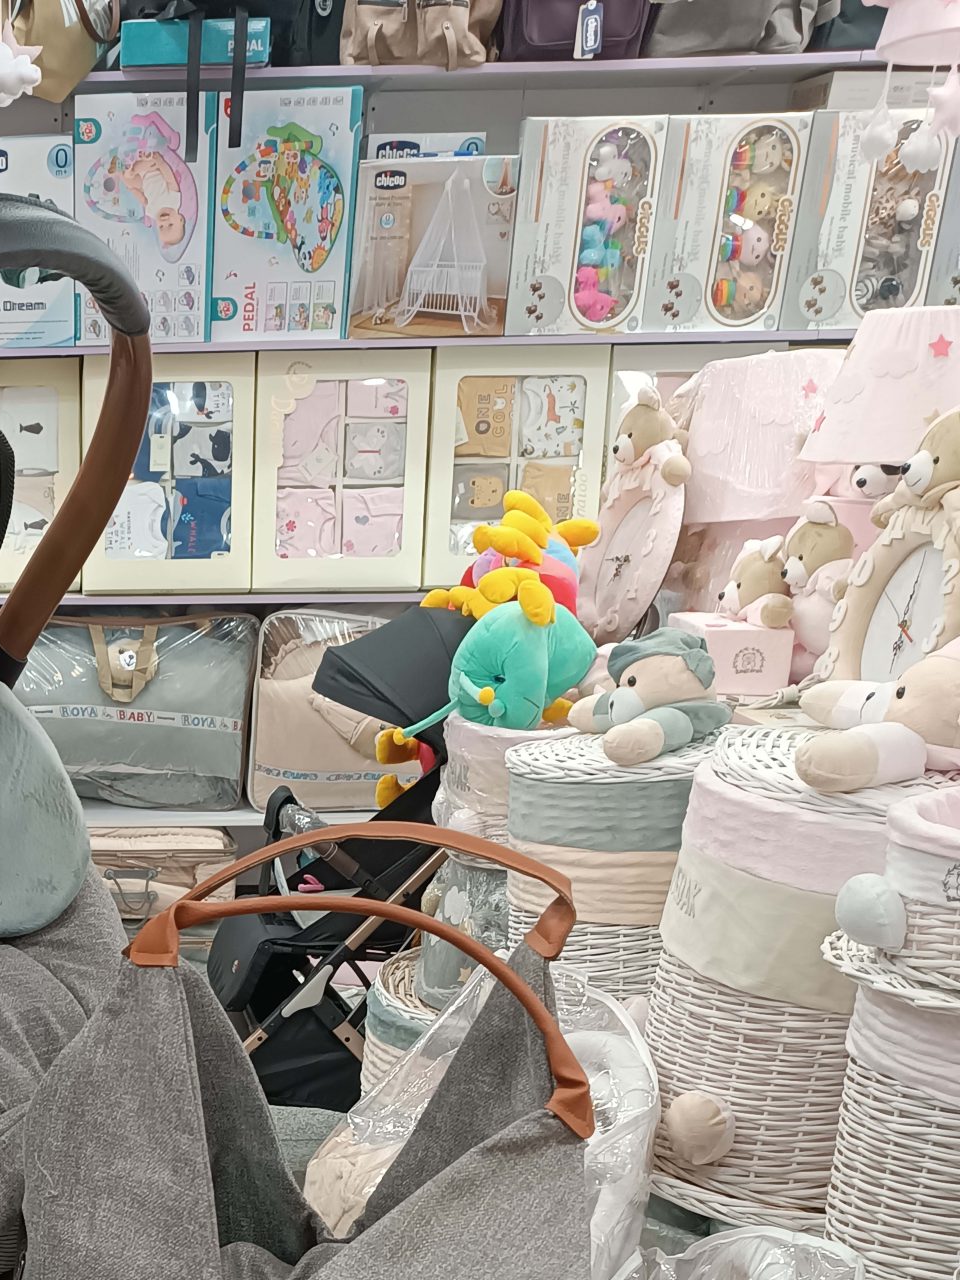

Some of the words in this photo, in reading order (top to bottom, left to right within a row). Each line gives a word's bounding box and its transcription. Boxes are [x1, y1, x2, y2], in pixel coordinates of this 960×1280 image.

[228, 39, 264, 52] PAL
[846, 134, 860, 180] musical
[839, 183, 853, 222] mobile
[832, 225, 848, 252] baby
[242, 281, 256, 332] PEDAL
[475, 393, 491, 435] ONE
[187, 520, 197, 553] WHALE
[60, 705, 98, 718] ROYA
[116, 709, 155, 723] BABY
[181, 714, 217, 728] ROYA
